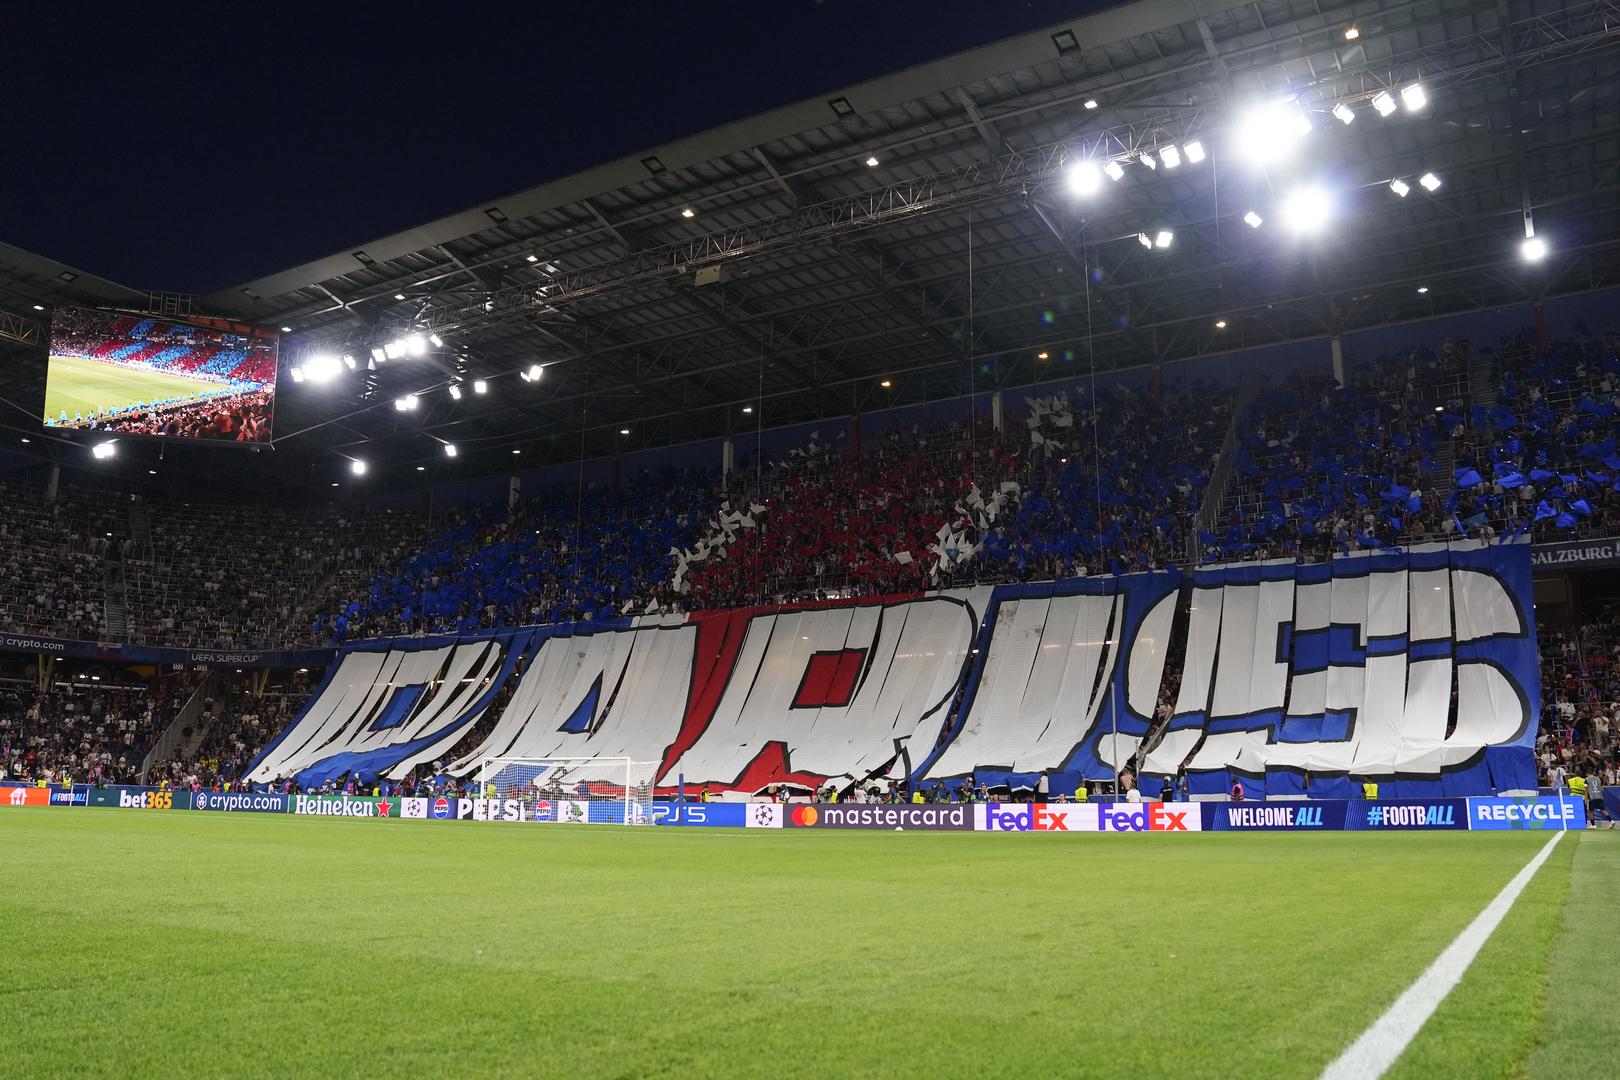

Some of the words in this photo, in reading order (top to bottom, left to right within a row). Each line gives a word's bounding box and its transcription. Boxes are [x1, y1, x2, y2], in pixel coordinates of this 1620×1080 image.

[6, 638, 64, 651] crypto.com
[191, 653, 214, 662] UEFA
[51, 793, 86, 802] #FOOTBALL
[120, 790, 172, 809] bet365
[210, 796, 281, 811] crypto.com
[295, 795, 374, 817] Heineken
[458, 799, 525, 821] PEPSI
[652, 806, 707, 823] PS5
[824, 806, 964, 825] mastercard
[986, 803, 1068, 831] FedEx
[1100, 803, 1187, 831] FedEx
[1228, 807, 1293, 826] WELCOME
[1295, 807, 1323, 826] ALL
[1367, 806, 1455, 826] #FOOTBALL
[1478, 804, 1575, 820] RECYCLE
